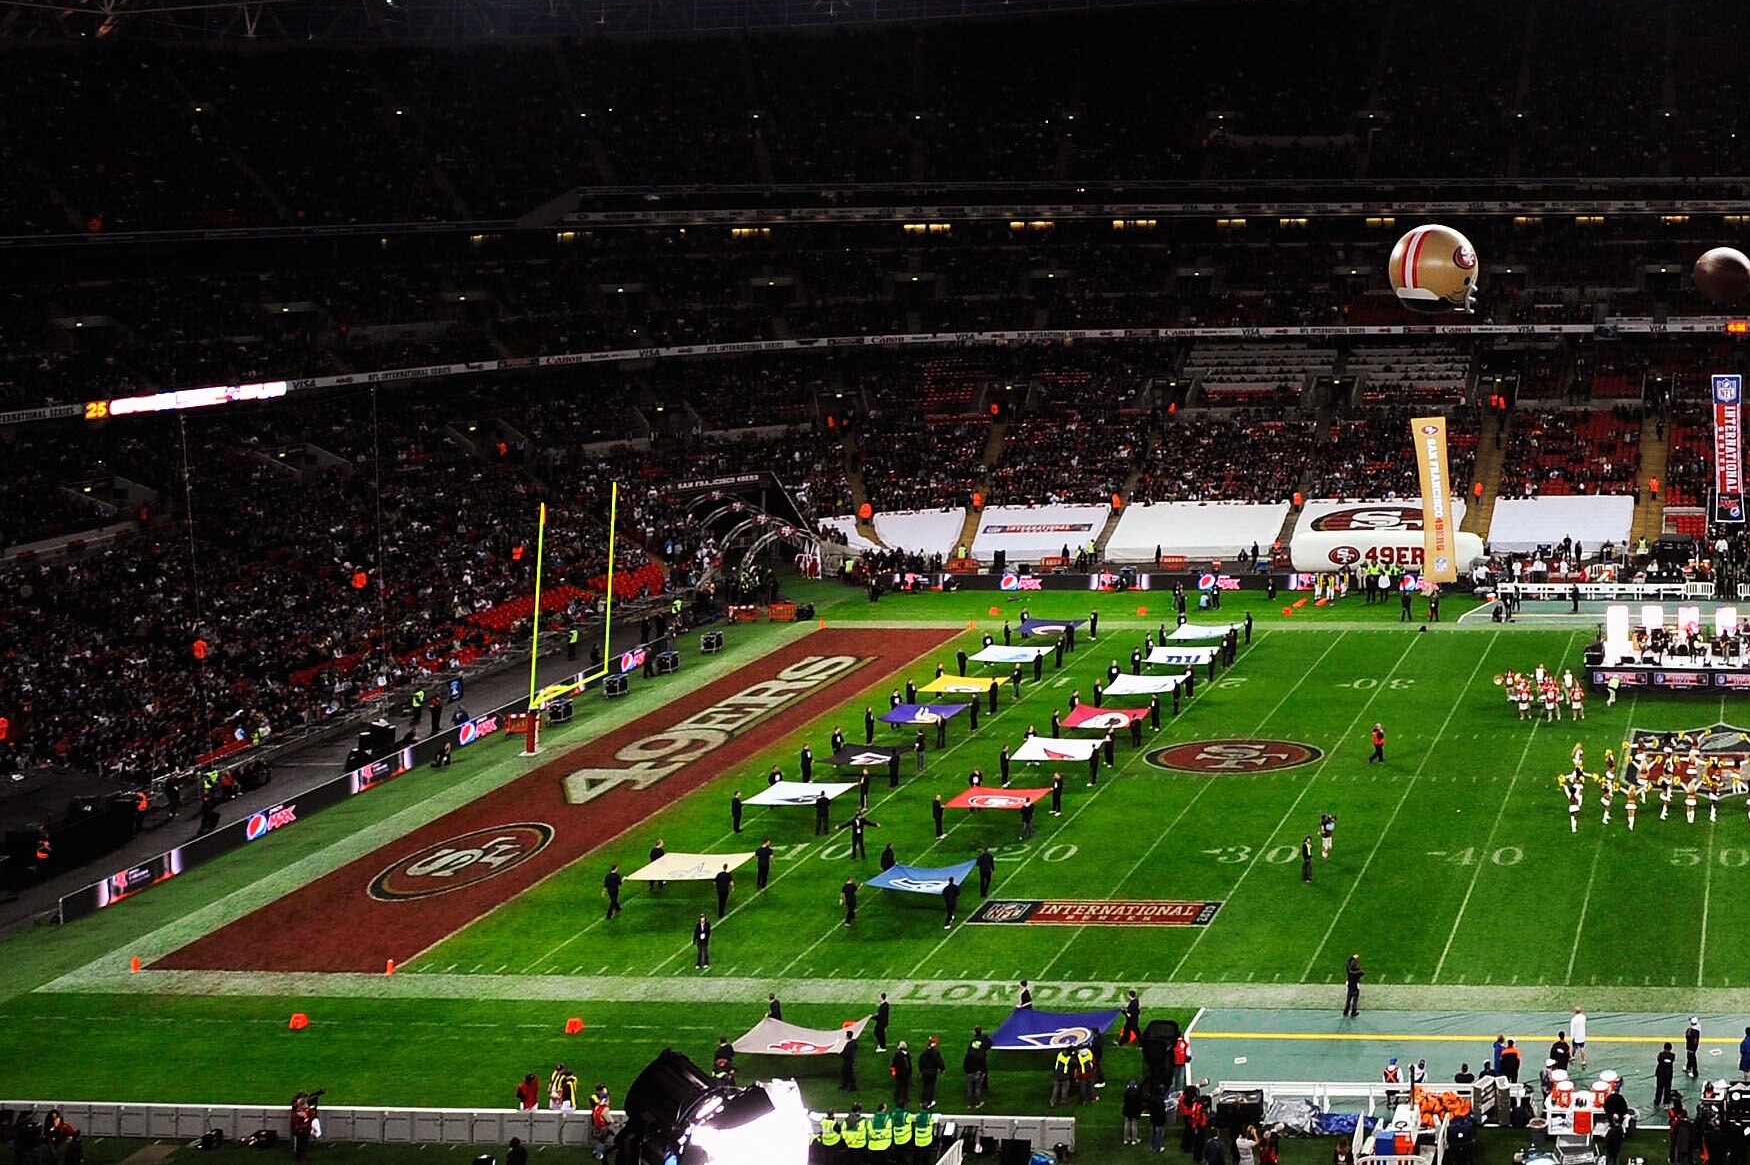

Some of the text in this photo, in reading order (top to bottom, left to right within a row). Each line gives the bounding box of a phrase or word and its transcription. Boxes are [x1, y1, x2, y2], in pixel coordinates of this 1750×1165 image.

[546, 355, 583, 364] Canon
[639, 349, 660, 358] VISA
[293, 379, 316, 390] VISA
[1719, 388, 1734, 399] NFL
[86, 402, 107, 419] 25
[1718, 426, 1726, 471] SERIES
[1724, 405, 1738, 493] INTERNATIONAL
[678, 481, 693, 490] SAN
[1435, 518, 1445, 551] 49ERS
[1365, 546, 1425, 565] 49ER
[560, 655, 866, 804] 49ERS
[267, 805, 296, 831] MAX
[1217, 845, 1300, 864] 30
[1447, 846, 1525, 866] 40
[1670, 848, 1750, 867] 50
[988, 908, 1023, 920] NFL
[1036, 904, 1194, 916] INTERNATIONAL
[900, 984, 1144, 1003] LONDON
